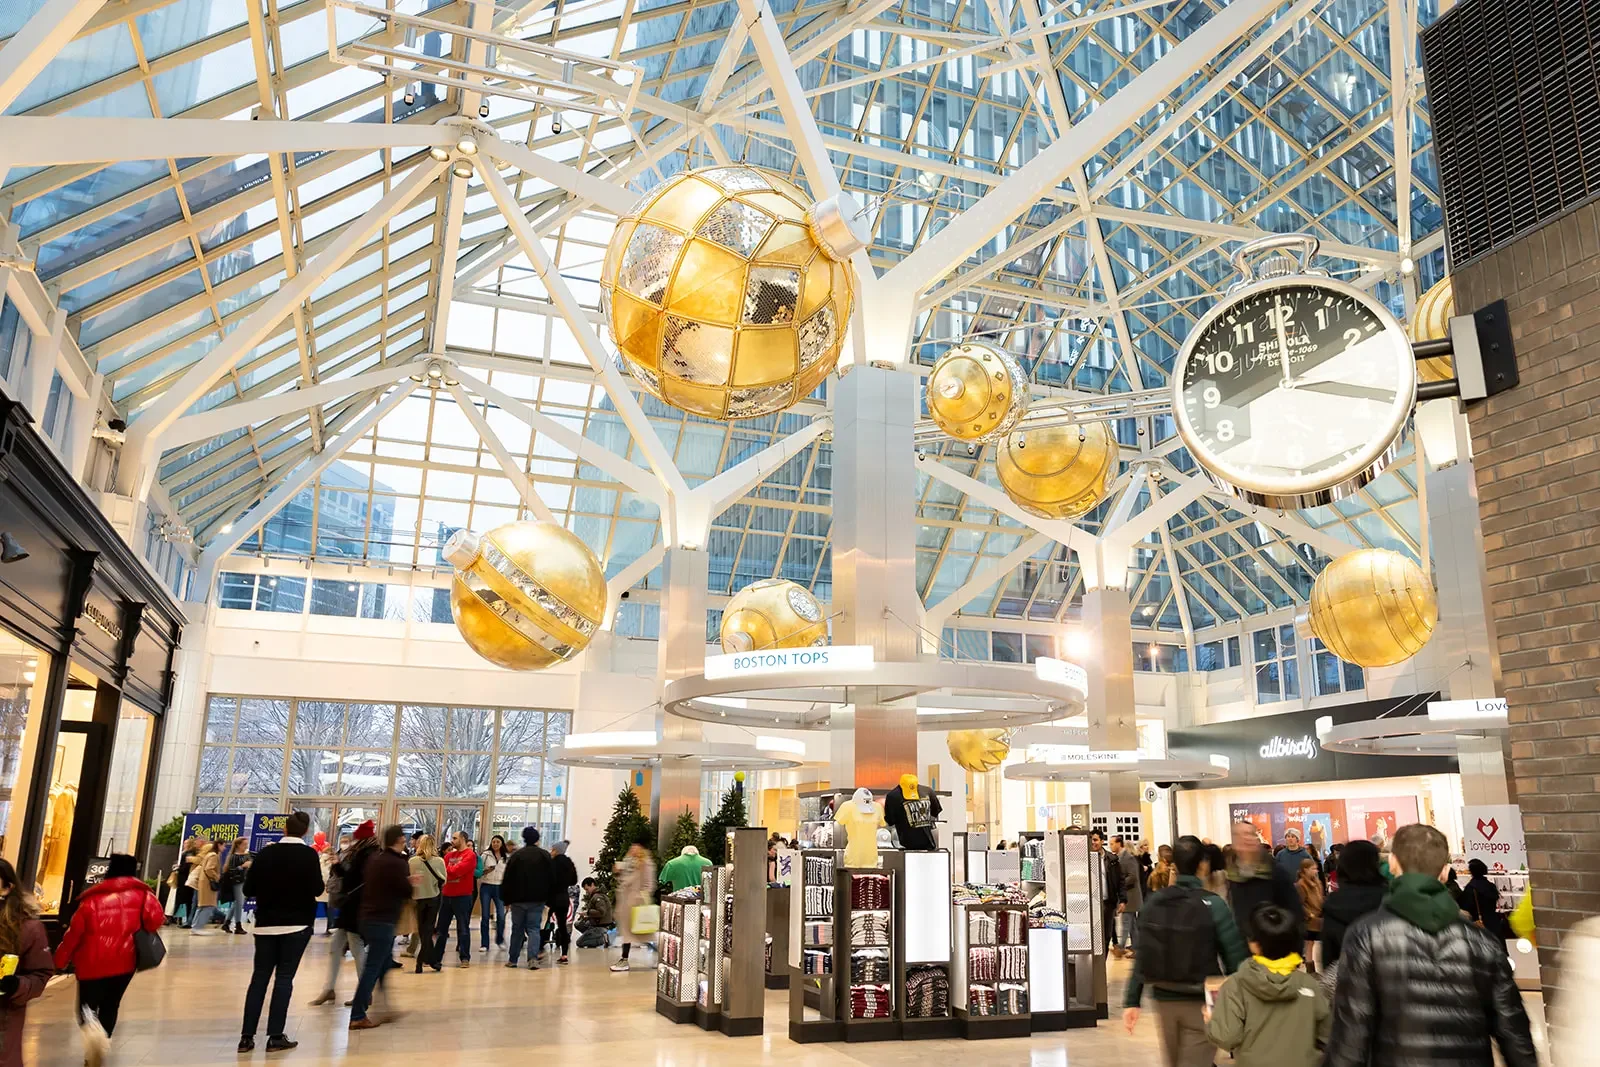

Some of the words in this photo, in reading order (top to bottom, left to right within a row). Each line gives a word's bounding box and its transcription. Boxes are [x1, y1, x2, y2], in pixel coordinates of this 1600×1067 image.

[1265, 305, 1295, 330] 12
[1314, 308, 1326, 331] 1
[1232, 322, 1254, 345] 11
[1258, 334, 1311, 351] SHIOLA
[1343, 328, 1362, 351] 2
[1205, 350, 1234, 375] 10
[1268, 354, 1306, 367] DEOIT
[1203, 386, 1221, 409] 9
[1216, 419, 1235, 442] 8
[734, 654, 787, 670] BOSTON
[792, 652, 829, 665] TOPS
[1067, 753, 1120, 761] MOLESKINE
[1259, 734, 1317, 759] allbirds
[211, 823, 240, 833] NIGHTS
[214, 832, 239, 841] LIGHT
[1469, 840, 1511, 854] lovepop
